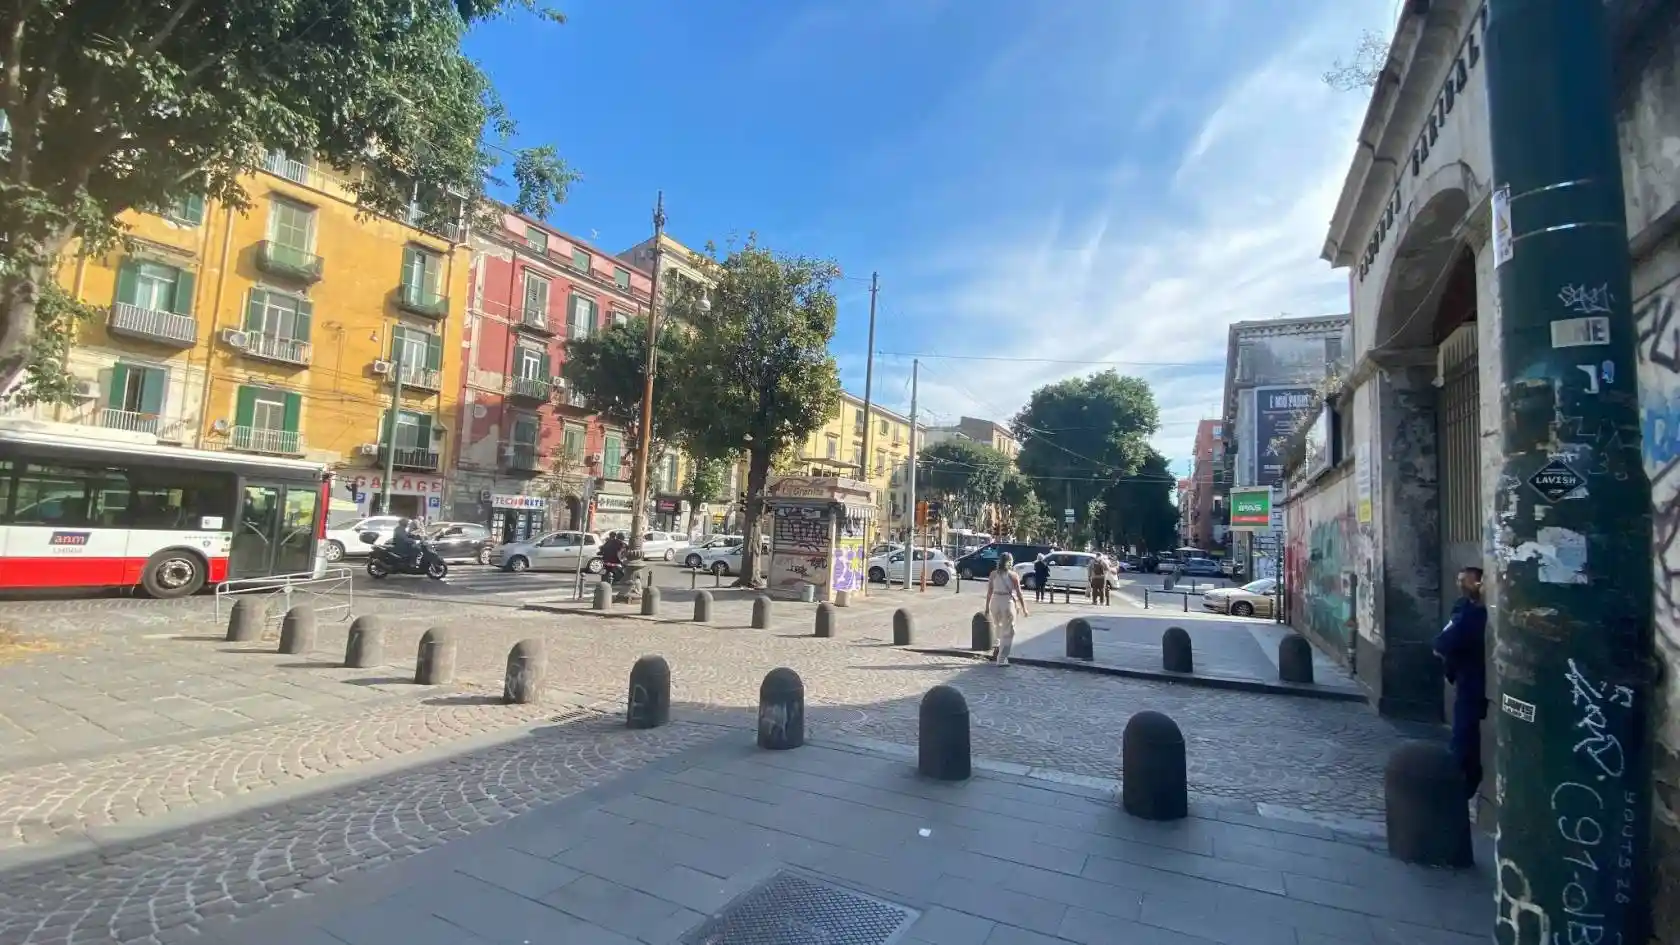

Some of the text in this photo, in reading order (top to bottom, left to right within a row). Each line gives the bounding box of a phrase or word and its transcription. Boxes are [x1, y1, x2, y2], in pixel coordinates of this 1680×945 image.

[355, 475, 442, 492] GARAGE
[1536, 475, 1577, 485] LAVISH
[54, 535, 85, 545] anm
